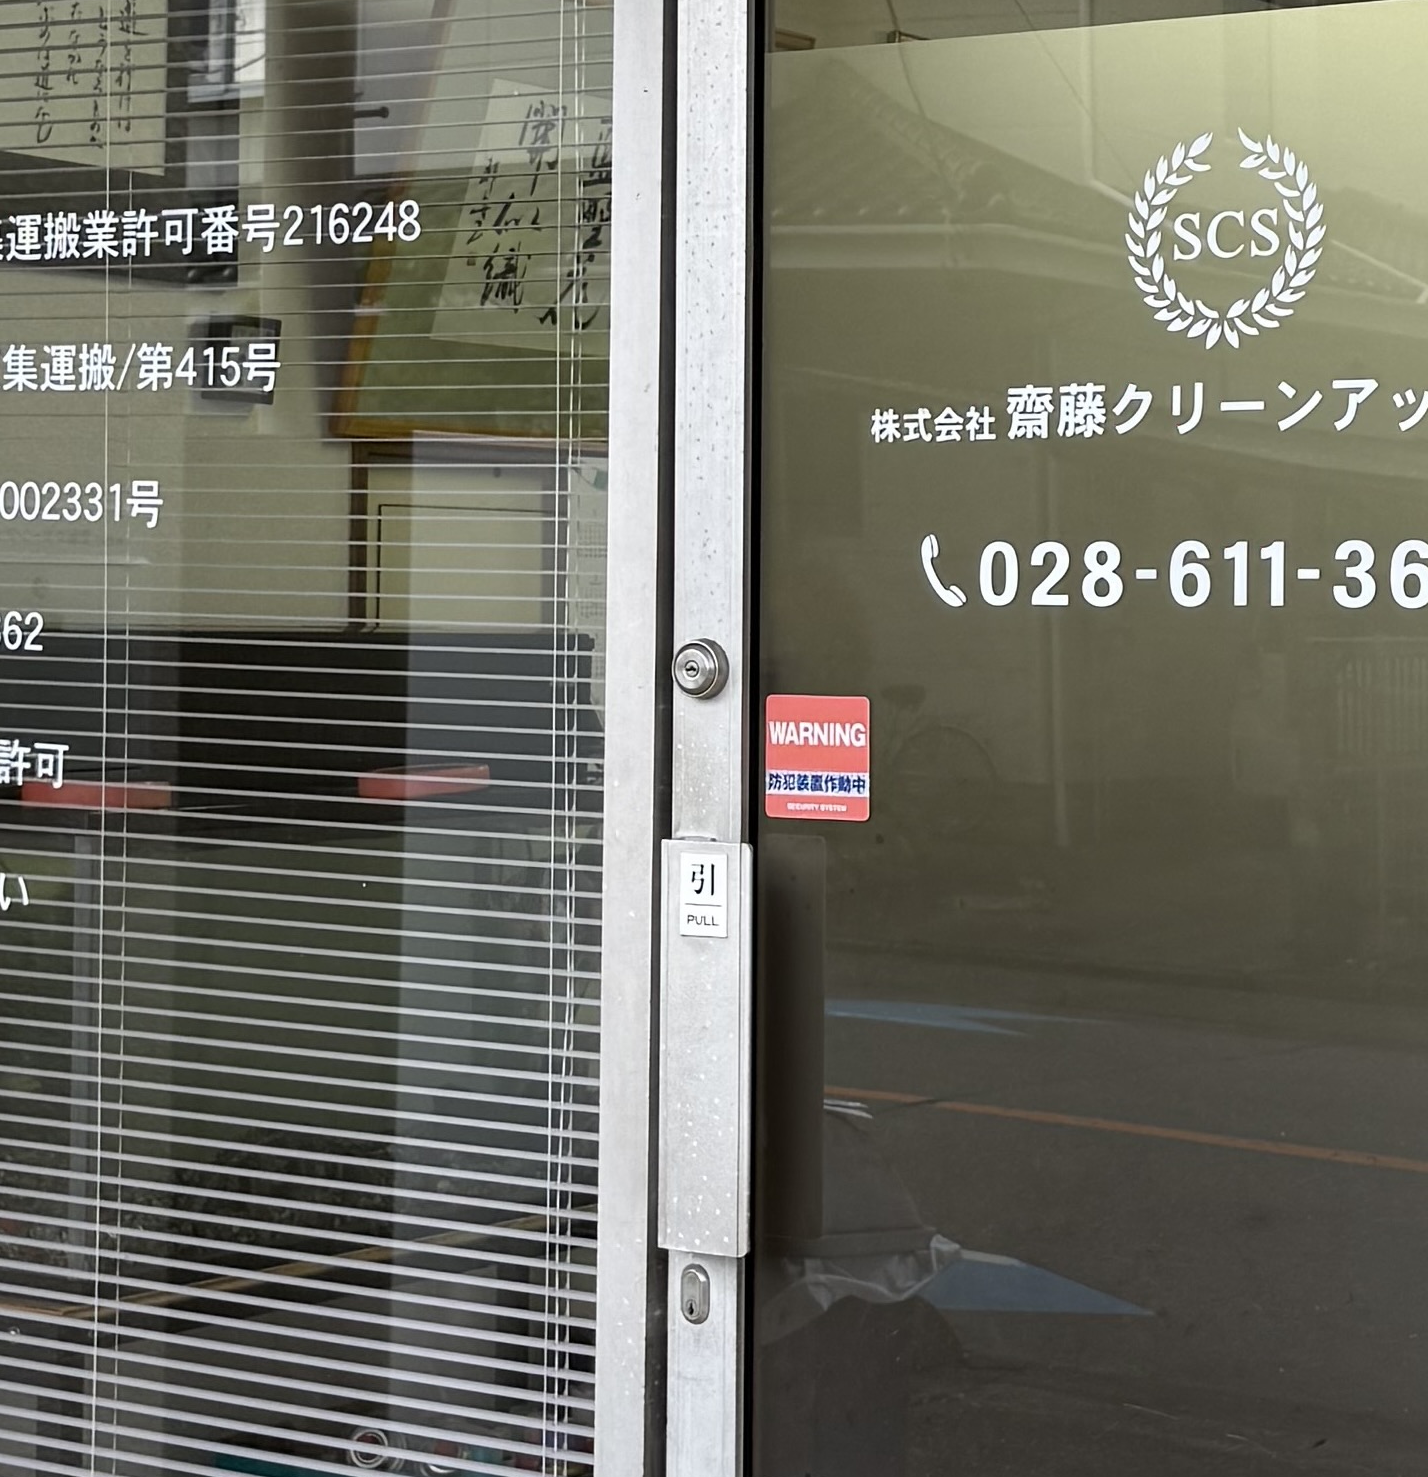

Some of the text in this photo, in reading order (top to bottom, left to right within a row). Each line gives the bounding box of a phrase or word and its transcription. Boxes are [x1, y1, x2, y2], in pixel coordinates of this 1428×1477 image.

[1172, 207, 1281, 262] SCS
[870, 405, 997, 444] 株式会社
[768, 720, 867, 748] WARNING
[767, 772, 866, 795] 防犯装置作動中
[691, 862, 716, 897] 引
[686, 914, 720, 927] PULL
